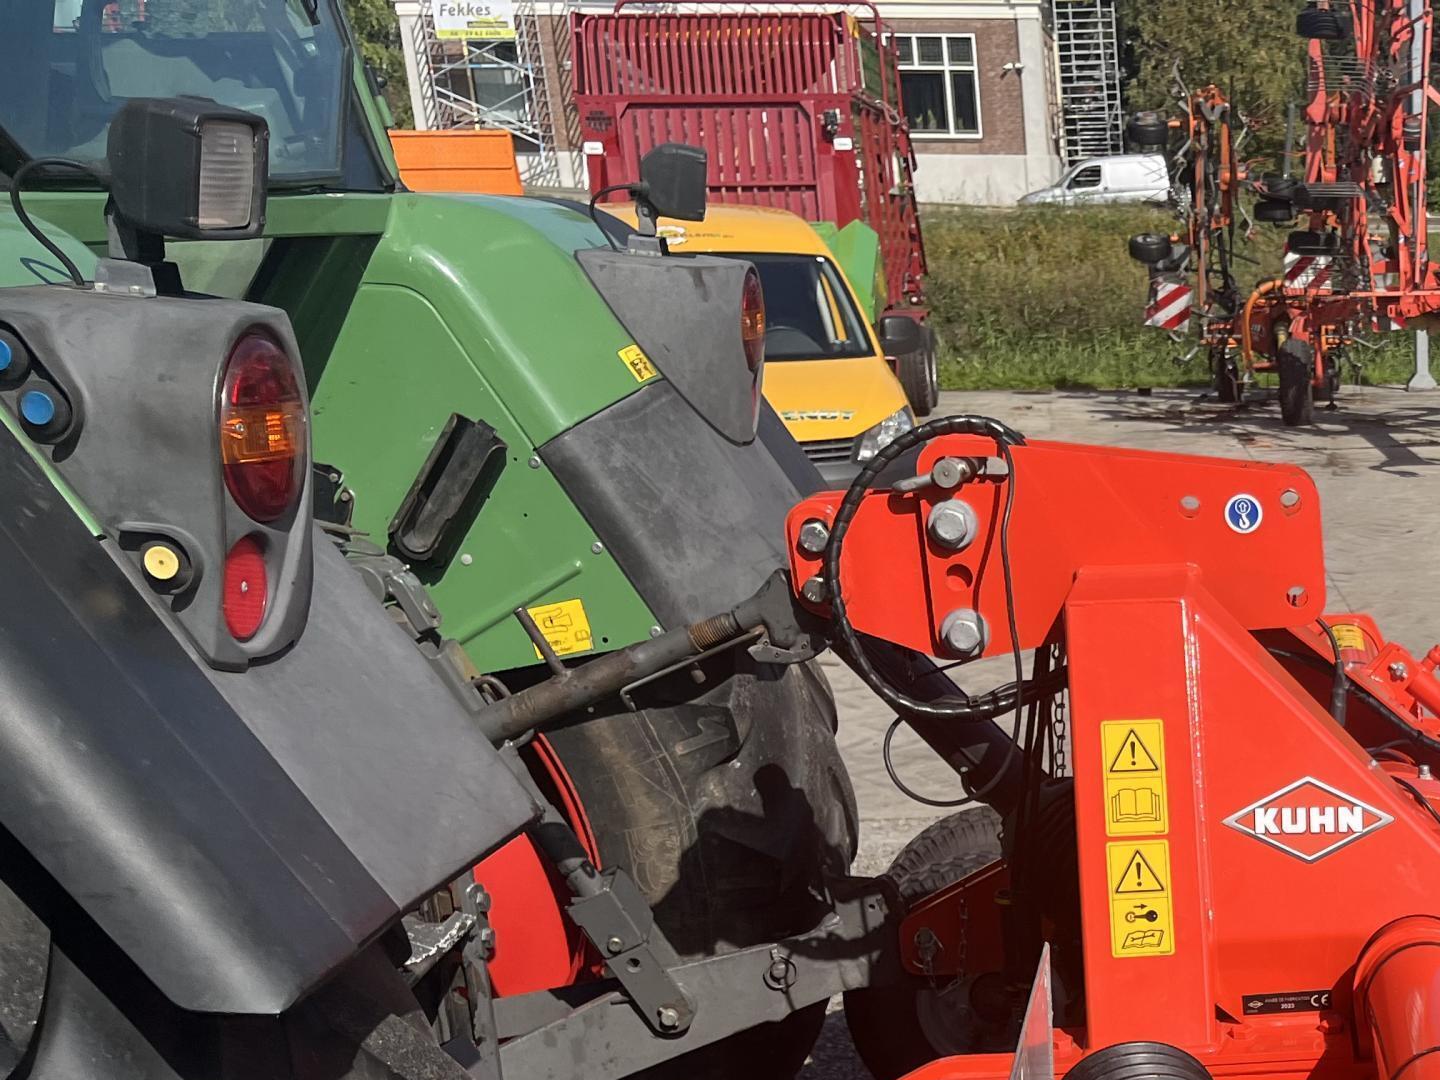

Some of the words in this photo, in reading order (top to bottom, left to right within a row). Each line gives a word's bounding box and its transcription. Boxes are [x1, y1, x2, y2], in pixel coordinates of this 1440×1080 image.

[440, 3, 491, 16] Fekkes
[1254, 806, 1363, 834] KUHN
[1310, 993, 1329, 1007] CE
